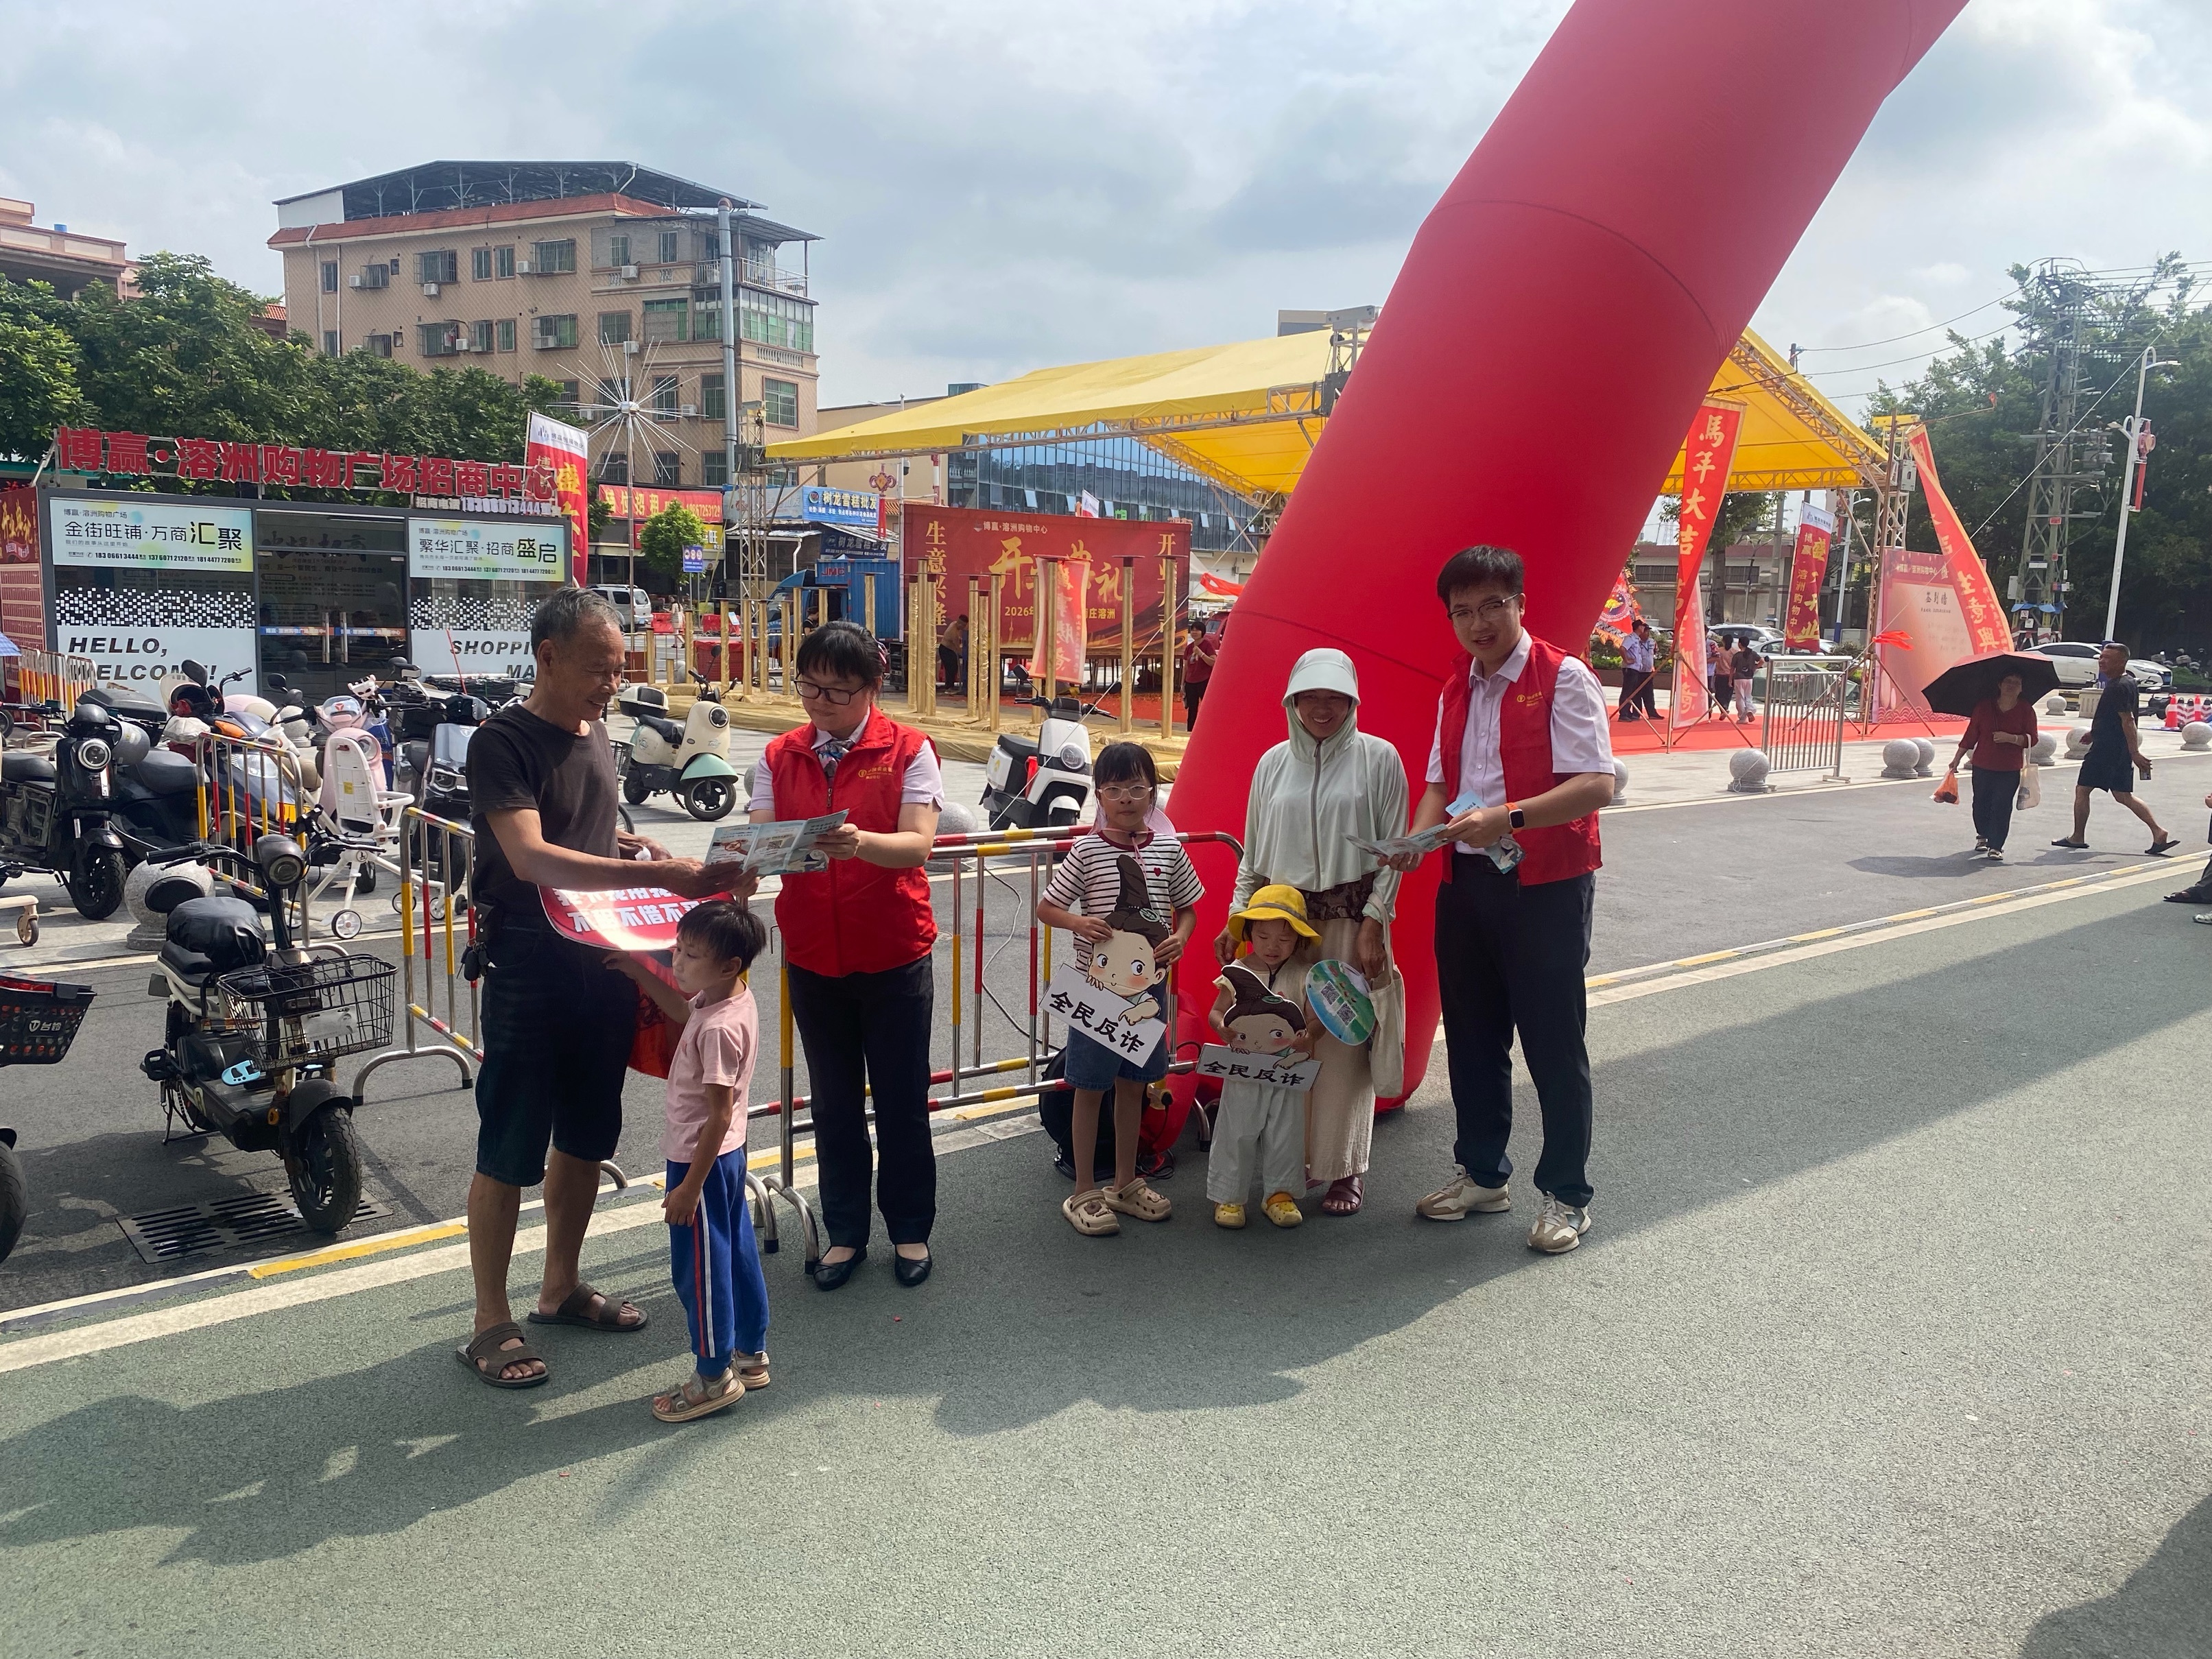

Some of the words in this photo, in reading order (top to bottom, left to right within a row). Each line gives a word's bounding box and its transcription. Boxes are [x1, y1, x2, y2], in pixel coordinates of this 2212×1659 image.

[64, 521, 242, 550] 金街旺铺·万商汇聚
[419, 538, 557, 563] 繁华汇聚·招商盛启
[822, 567, 845, 576] JMC
[69, 637, 167, 657] HELLO,
[450, 641, 535, 655] SHOPPI
[40, 1022, 62, 1031] 台铃
[1049, 990, 1145, 1053] 全民反诈
[1204, 1061, 1305, 1086] 全民反诈
